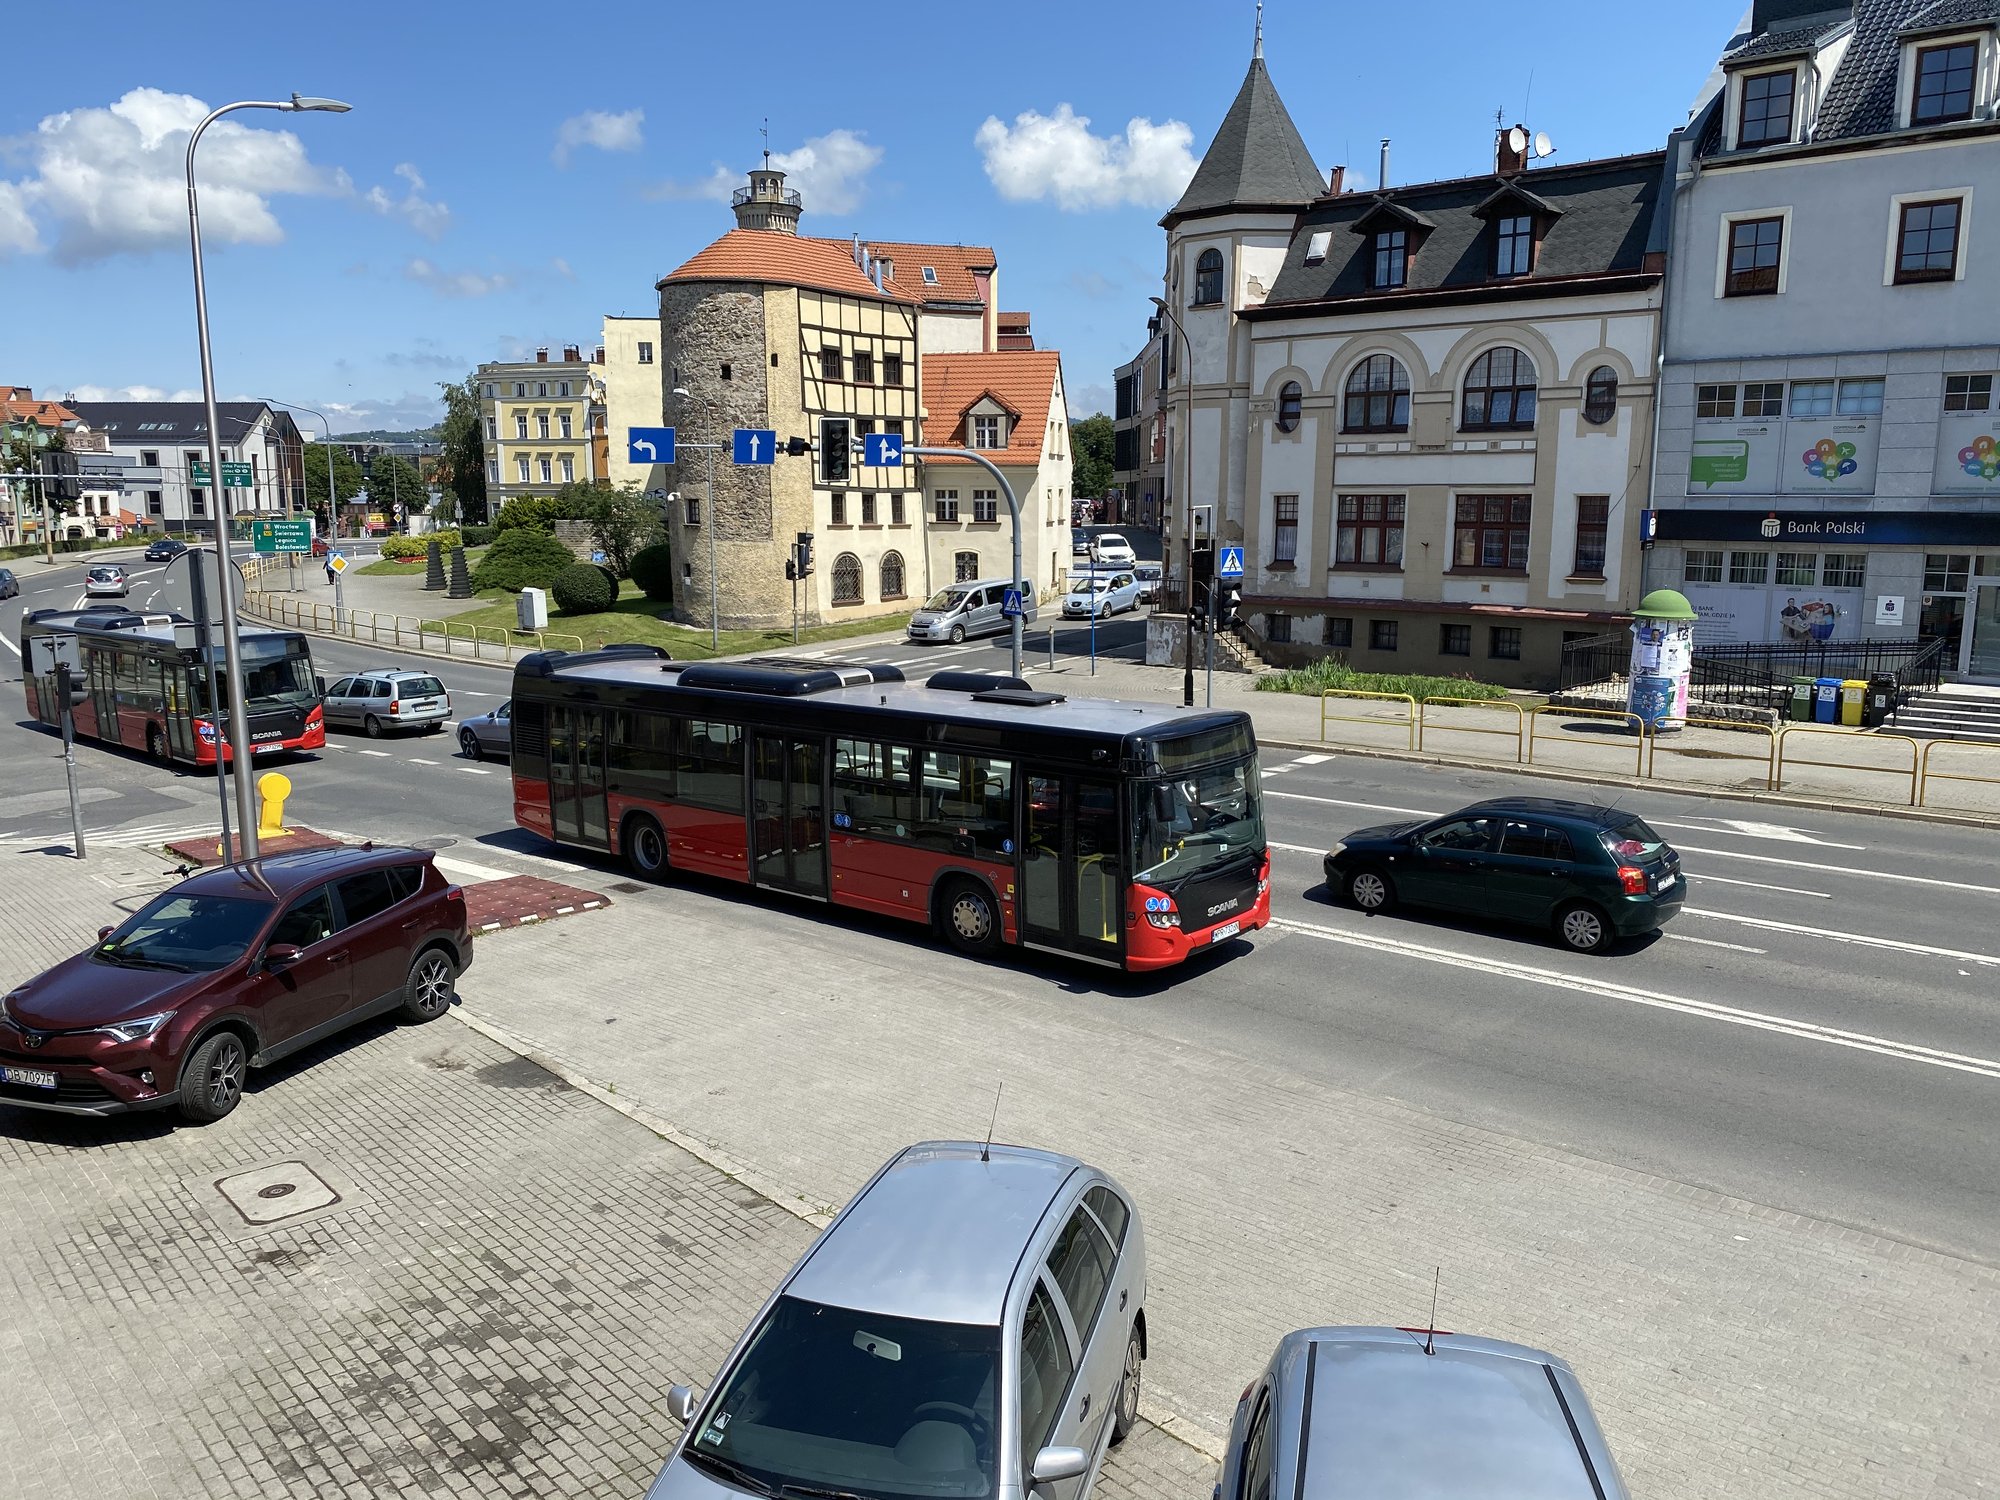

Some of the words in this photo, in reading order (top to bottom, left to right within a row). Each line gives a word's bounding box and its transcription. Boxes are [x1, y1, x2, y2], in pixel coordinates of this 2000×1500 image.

[1787, 520, 1821, 533] Bank
[1825, 521, 1866, 534] Polski
[251, 730, 283, 740] SCANIA
[1207, 898, 1239, 917] SCANIA
[6, 1068, 21, 1081] DB
[23, 1070, 53, 1085] 7097F
